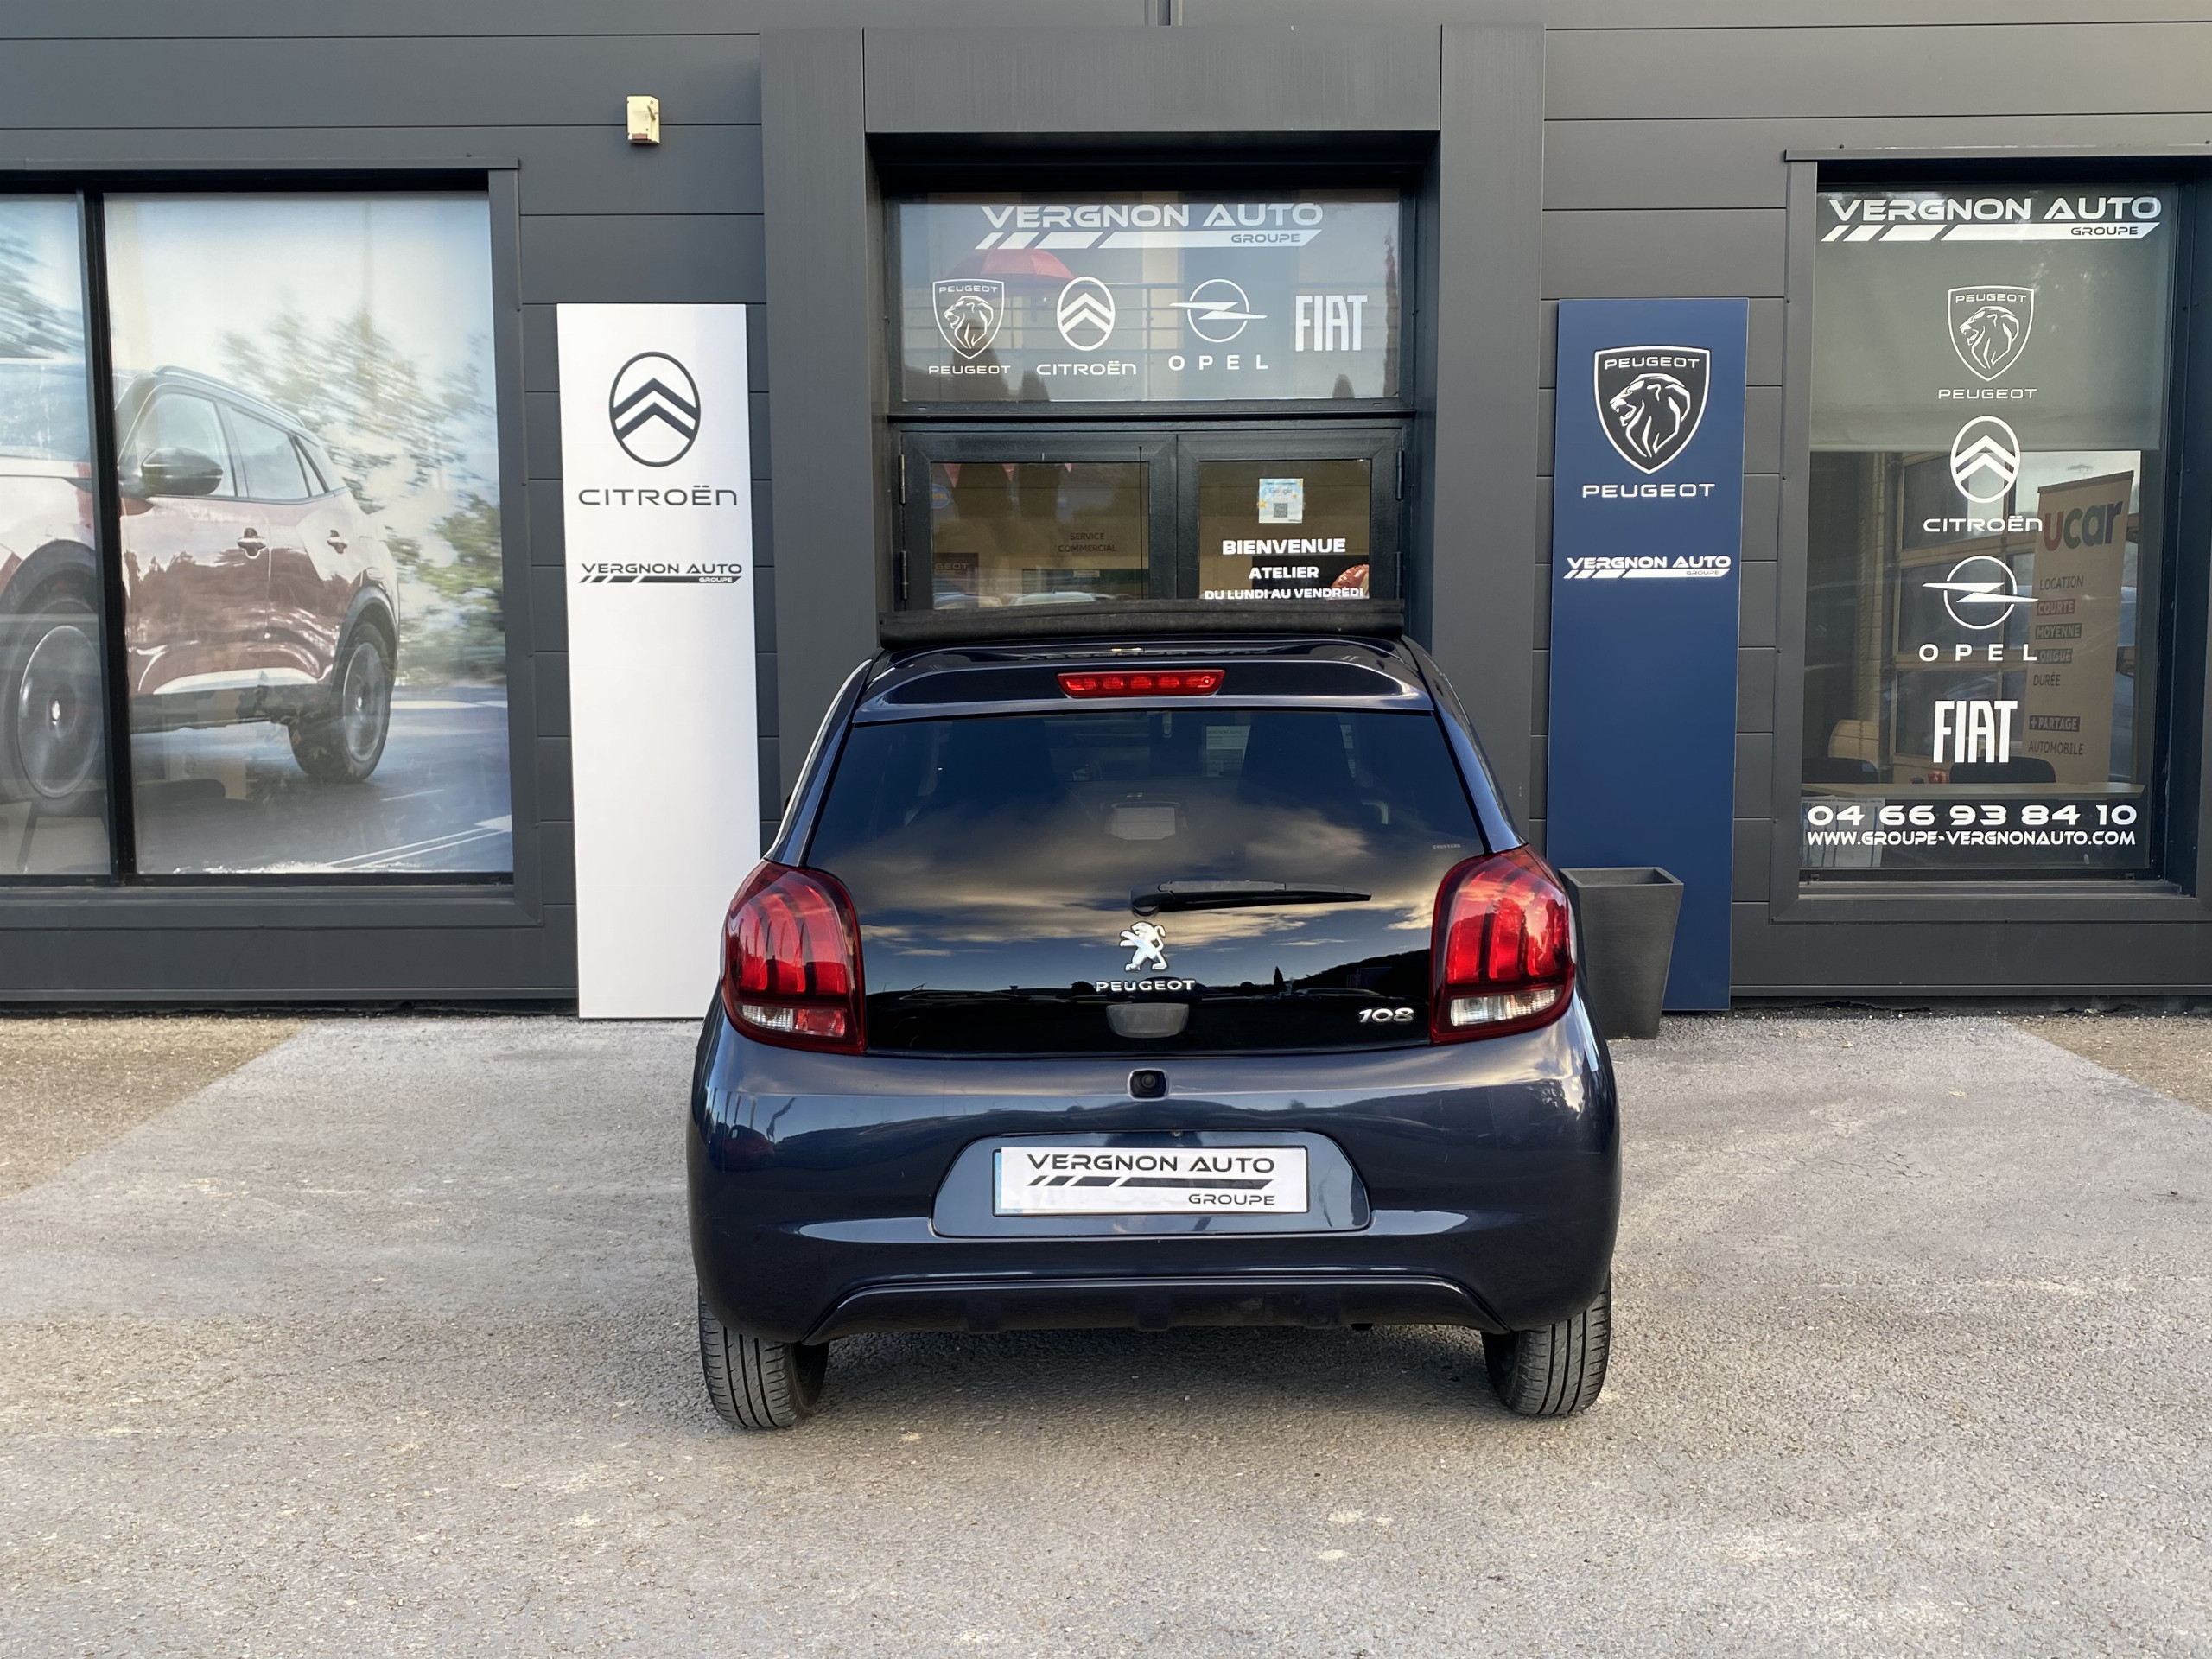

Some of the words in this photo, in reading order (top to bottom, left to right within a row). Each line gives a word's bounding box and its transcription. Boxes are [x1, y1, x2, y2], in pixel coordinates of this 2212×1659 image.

[982, 205, 1190, 228] VERGNON
[1202, 203, 1324, 226] AUTO
[1829, 197, 2031, 221] VERGNON
[2043, 196, 2162, 220] AUTO
[2070, 226, 2139, 236] GROUPE
[1230, 233, 1300, 244] GROUPE
[938, 284, 998, 294] PEUGEOT
[1955, 293, 2027, 303] PEUGEOT
[1295, 295, 1368, 351] FIAT
[928, 365, 1012, 375] PEUGEOT
[1169, 354, 1269, 372] OPEL
[1605, 356, 1700, 371] PEUGEOT
[1938, 388, 2037, 399] PEUGEOT
[1582, 483, 1715, 499] PEUGEOT
[2044, 500, 2123, 551] ucar
[1070, 532, 1105, 541] SERVICE
[1058, 543, 1117, 553] COMMERCIAL
[1222, 537, 1346, 556] BIENVENUE
[582, 563, 679, 575] VERGNON
[686, 563, 743, 575] AUTO
[1567, 556, 1667, 569] VERGNON
[1671, 555, 1732, 569] AUTO
[1248, 566, 1319, 580] ATELIER
[2039, 575, 2083, 590] LOCATION
[1205, 589, 1224, 600] DU
[1227, 588, 1268, 600] LUNDI
[1270, 588, 1292, 599] AU
[1293, 587, 1363, 598] VENDREDI
[2037, 601, 2074, 615] COURTE
[2037, 624, 2081, 638] MOYENNE
[1918, 643, 2037, 662] OPEL
[1933, 700, 2018, 763] FIAT
[2029, 741, 2084, 755] AUTOMOBILE
[1807, 805, 1866, 826] 04
[1878, 805, 1936, 826] 66
[1949, 804, 2007, 826] 93
[2021, 804, 2082, 826] 84
[2095, 804, 2137, 826] 10
[1807, 831, 2136, 846] WWW.GROUPE-VERGNONAUTO.COM
[1095, 979, 1197, 994] PEUGEOT
[1358, 1007, 1414, 1023] 108
[1027, 1154, 1178, 1172] VERGNON
[1188, 1156, 1274, 1173] AUTO
[1188, 1193, 1274, 1206] GROUPE
